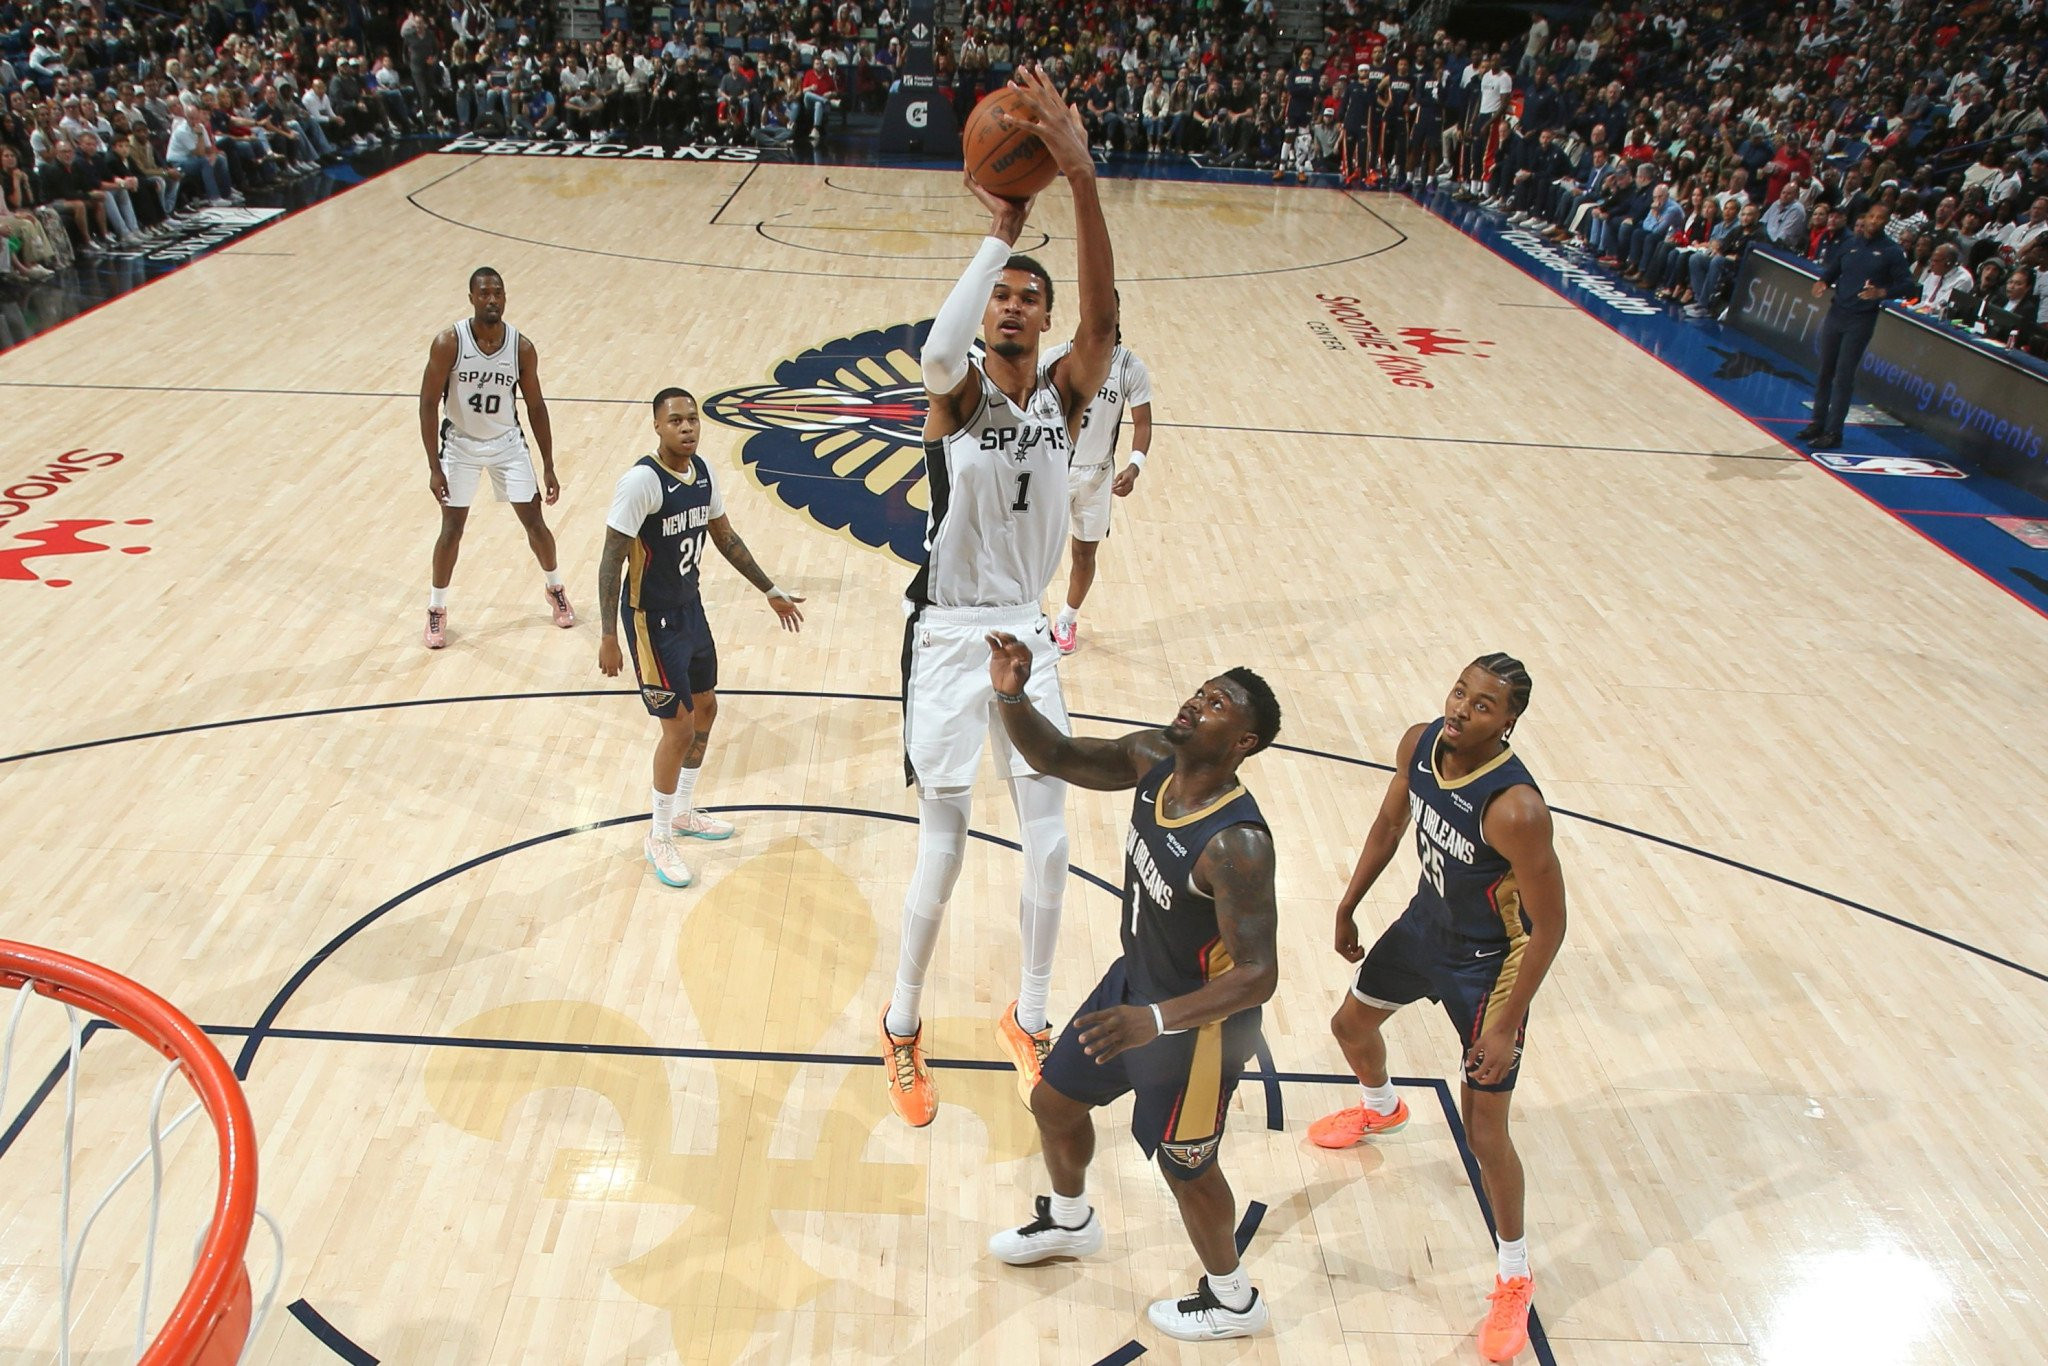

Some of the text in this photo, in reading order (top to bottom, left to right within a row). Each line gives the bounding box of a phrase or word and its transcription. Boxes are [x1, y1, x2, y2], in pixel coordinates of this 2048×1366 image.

[438, 139, 761, 161] PELICANS
[1562, 272, 1663, 315] Health
[1742, 278, 1819, 342] SHIFT
[1306, 321, 1346, 351] CENTER
[1315, 293, 1434, 390] SMOOTHIE KING
[458, 370, 514, 388] SPURS
[468, 393, 501, 414] 40
[1863, 351, 2042, 458] owering Payments
[0, 447, 124, 528] SMOO
[1011, 471, 1033, 513] 1
[662, 510, 687, 537] NEW
[1422, 804, 1475, 865] ORLEANS
[1132, 838, 1173, 911] ORLEANS
[1419, 831, 1445, 898] 25
[1131, 881, 1140, 937] 1
